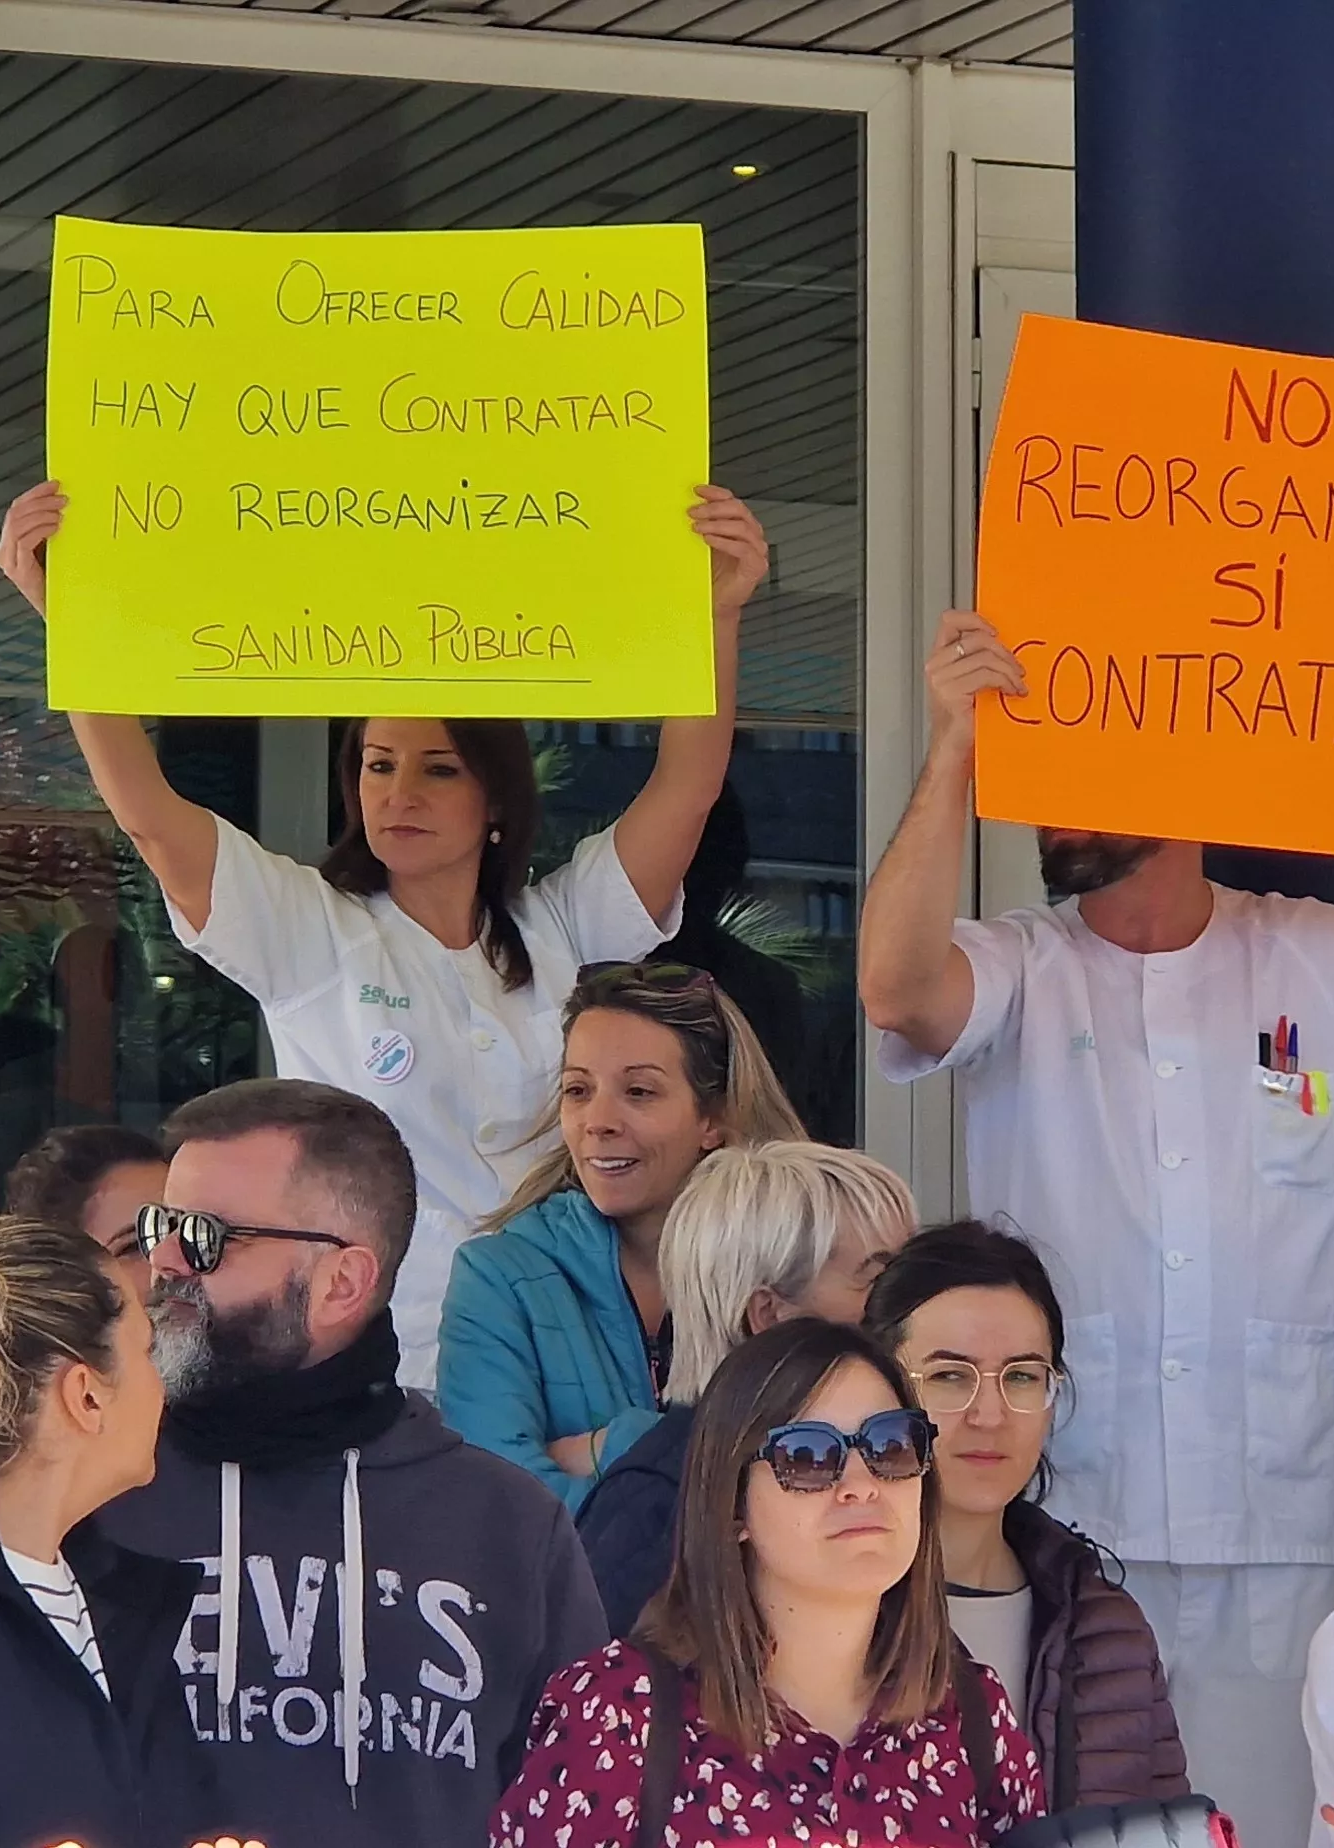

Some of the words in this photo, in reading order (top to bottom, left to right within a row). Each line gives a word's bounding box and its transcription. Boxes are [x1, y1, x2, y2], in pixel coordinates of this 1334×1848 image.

[64, 255, 214, 330] PARA
[277, 260, 462, 325] OFRECER
[500, 271, 684, 332] CALIDAD
[92, 379, 196, 431] HAY
[238, 385, 350, 436] QUE
[380, 373, 666, 436] CONTRATAR
[1224, 367, 1331, 448] NO
[113, 482, 182, 539] NO
[1211, 553, 1286, 630] SÍ
